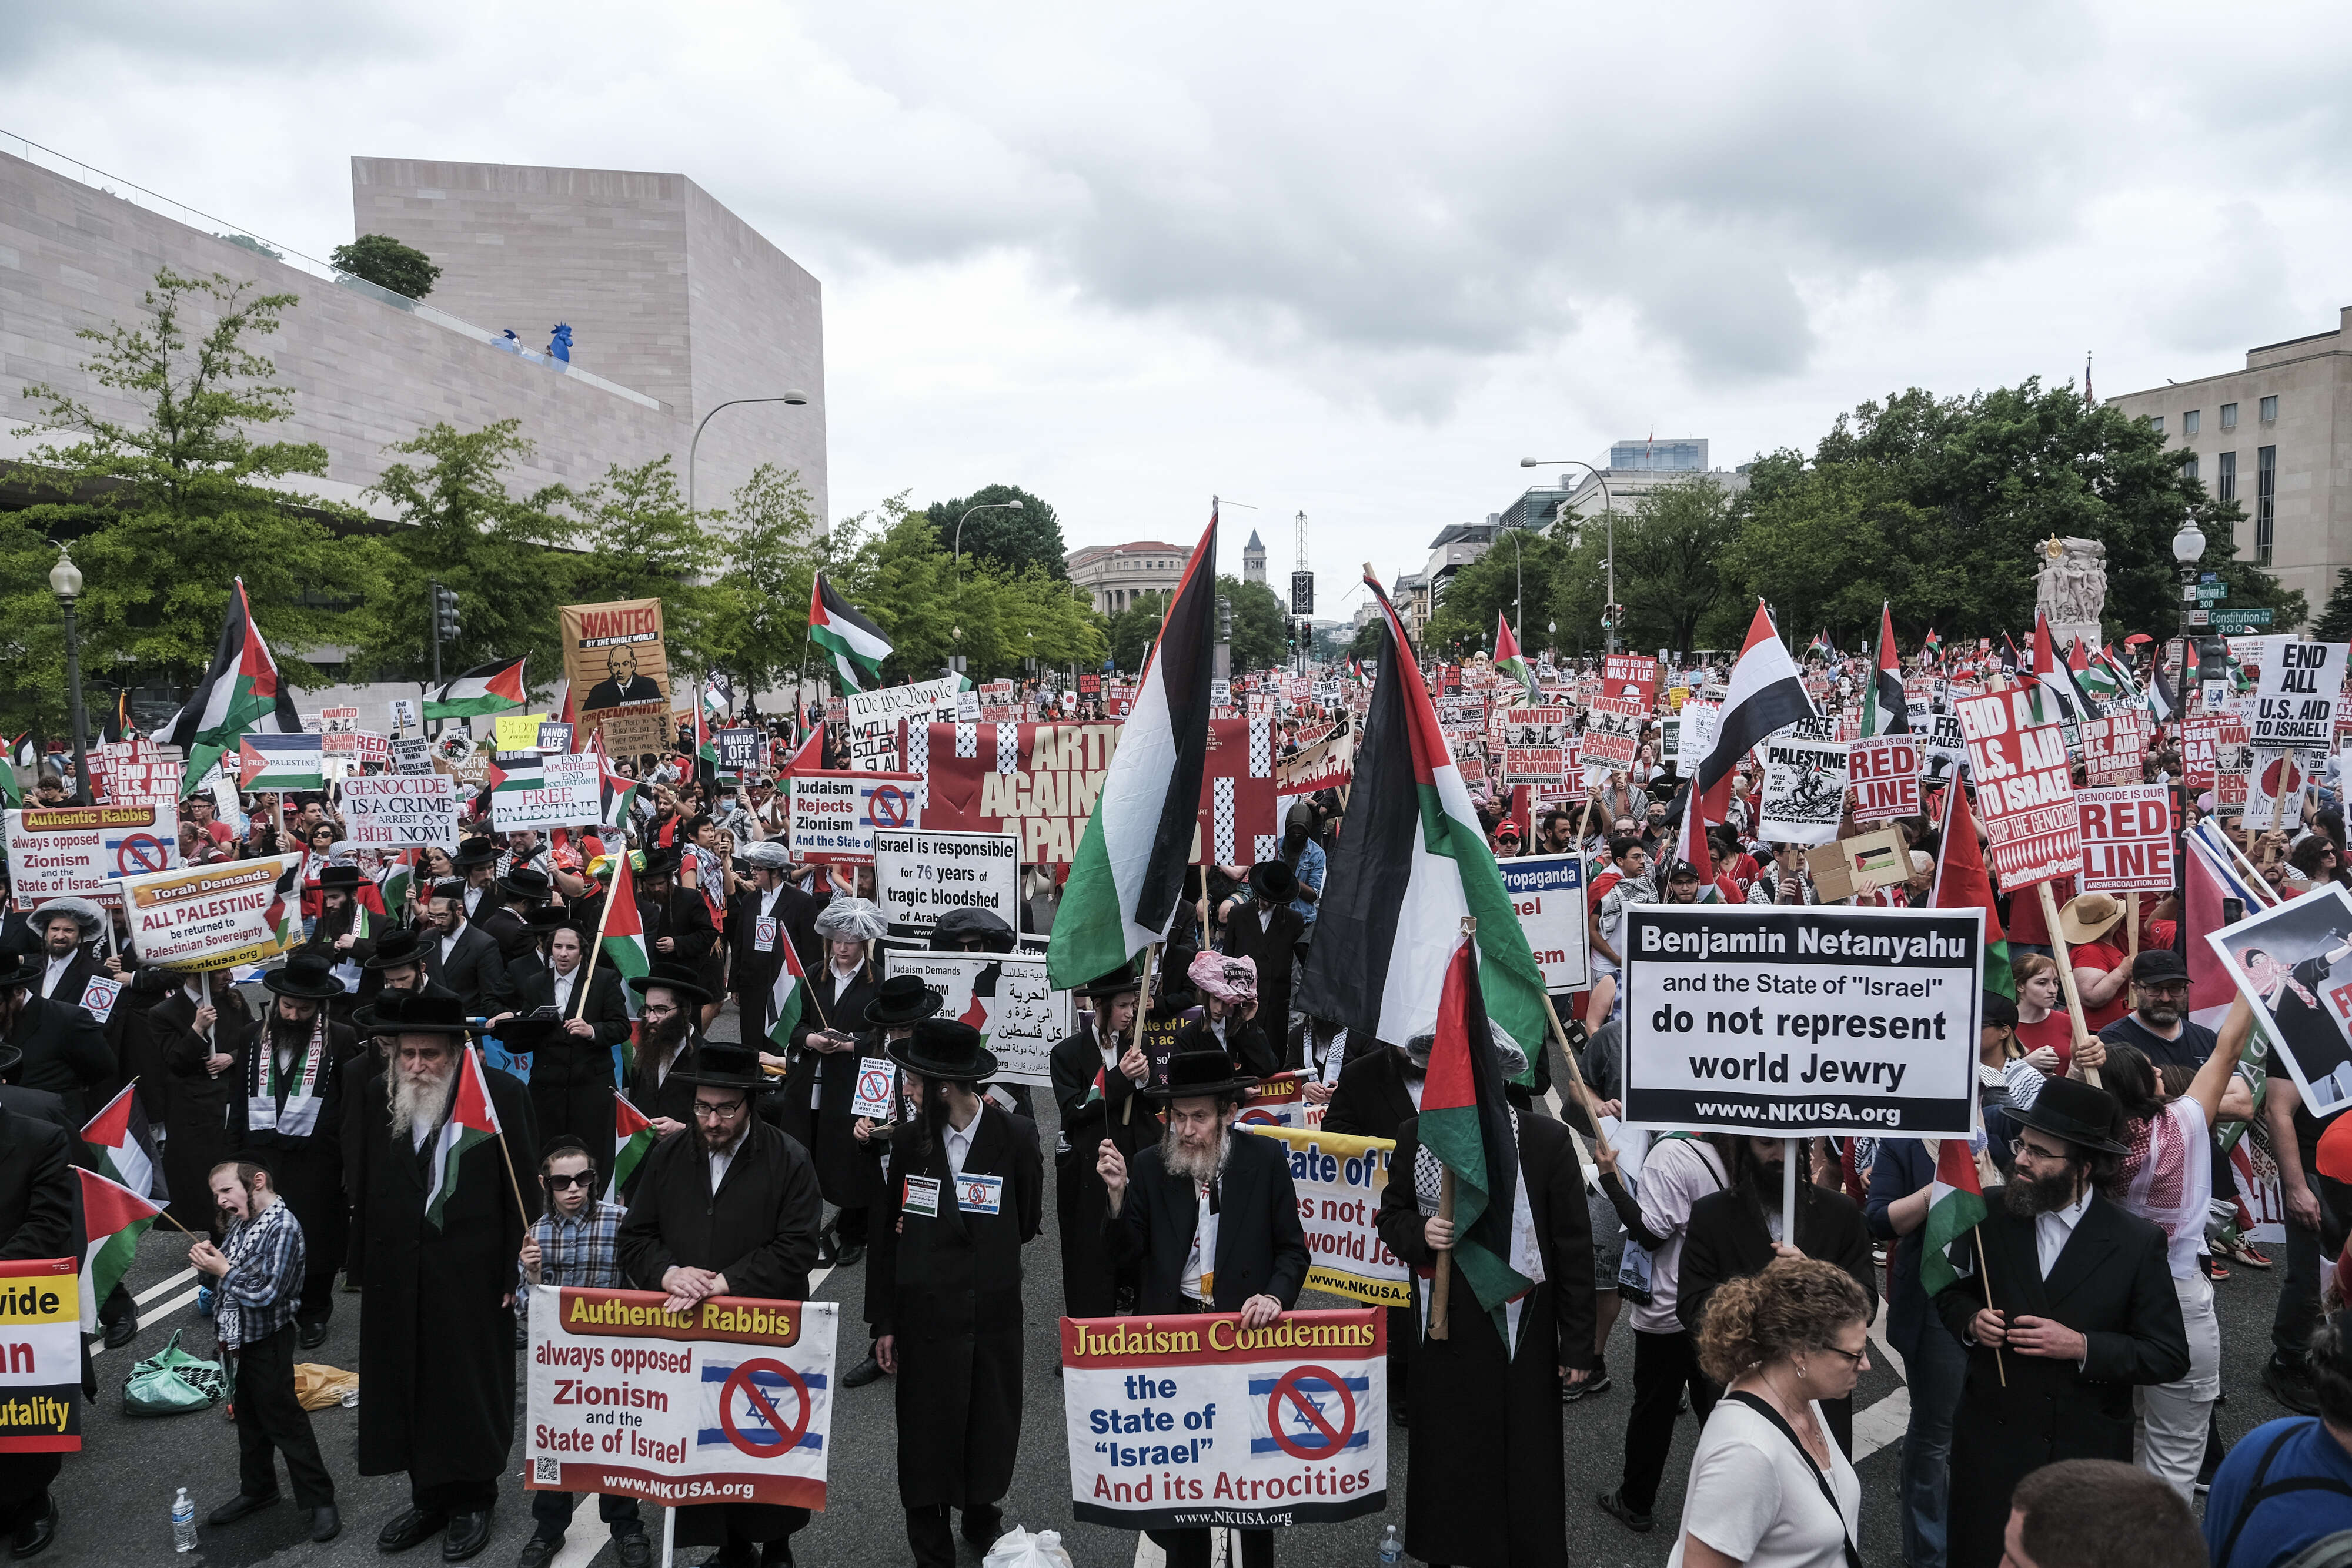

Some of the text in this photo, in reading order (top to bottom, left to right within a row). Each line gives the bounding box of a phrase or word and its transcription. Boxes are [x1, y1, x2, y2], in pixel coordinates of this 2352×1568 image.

[2197, 585, 2219, 598] Pennsylvania
[580, 608, 656, 638] WANTED
[2211, 611, 2259, 623] Constitution
[610, 636, 632, 645] WHOLE
[633, 633, 655, 643] WORLD!
[1608, 658, 1655, 669] BIDEN'S RED LINE
[2282, 644, 2327, 669] END
[1607, 667, 1653, 681] WAS A LIE!
[2280, 669, 2317, 693] ALL
[1321, 681, 1338, 691] FREE
[853, 695, 878, 714] We
[901, 680, 952, 707] People
[323, 708, 357, 718] WANTED
[1508, 710, 1562, 723] WANTED
[1956, 696, 2008, 741] END
[2259, 698, 2330, 720] U.S. AID
[852, 719, 895, 740] WILL
[2255, 721, 2327, 738] TO ISRAEL!
[393, 738, 426, 747] RESISTANCE
[723, 734, 754, 745] HANDS
[402, 745, 427, 754] JUSTIFIED
[729, 744, 751, 760] OFF
[1507, 750, 1562, 761] BENJAMIN
[1769, 747, 1847, 770] PALESTINE
[1969, 738, 2017, 783] U.S.
[2019, 727, 2066, 773] AID
[544, 762, 599, 773] APARTHEID
[561, 755, 583, 764] END
[1506, 762, 1562, 773] NETANYAHU
[544, 778, 596, 788] OCCUPATION!!
[562, 771, 583, 780] END
[344, 778, 448, 795] GENOCIDE
[522, 787, 573, 805] FREE
[796, 781, 853, 795] Judaism
[1978, 767, 2074, 817] TO ISRAEL
[2077, 788, 2164, 803] GENOCIDE IS OUR
[350, 797, 453, 814] IS A CRIME
[496, 801, 599, 823] PALESTINE
[797, 798, 853, 815] Rejects
[28, 808, 151, 827] Authentic Rabbis
[377, 815, 418, 824] ARREST
[796, 816, 853, 830] Zionism
[1988, 803, 2078, 845] STOP THE GENOCIDE
[2079, 800, 2167, 840] RED
[12, 833, 99, 851] always opposed
[357, 826, 450, 842] BIBI NOW!
[795, 834, 861, 847] And the State
[877, 835, 1013, 859] Israel is responsible
[24, 854, 89, 868] Zionism
[2082, 843, 2171, 878] LINE
[901, 865, 988, 884] for 76 years of
[1501, 866, 1576, 890] Propaganda
[17, 877, 65, 892] State of
[151, 870, 270, 900] Torah Demands
[2087, 879, 2169, 890] ANSWERCOALITION.ORG
[887, 887, 999, 908] tragic bloodshed
[142, 892, 266, 931] ALL PALESTINE
[900, 912, 911, 922] of
[169, 918, 235, 940] be returned to
[145, 926, 263, 959] Palestinian Sovereignty
[1641, 925, 1966, 964] Benjamin Netanyahu
[893, 965, 960, 975] Judaism Demands
[1009, 983, 1049, 1004] الحرية
[1662, 973, 1943, 998] and the State of "Israel"
[1015, 1007, 1034, 1021] غزة
[1652, 1003, 1946, 1044] do not represent
[998, 1022, 1063, 1042] كل فلسطين
[1689, 1052, 1907, 1092] world Jewry
[1695, 1101, 1902, 1126] www.NKUSA.org
[569, 1297, 791, 1336] Authentic Rabbis
[1073, 1318, 1375, 1357] Judaism Condemns
[536, 1340, 693, 1375] always opposed
[553, 1379, 669, 1413] Zionism
[1124, 1374, 1177, 1400] the
[586, 1410, 643, 1427] and the
[1090, 1403, 1216, 1435] State of
[536, 1424, 687, 1463] State of Israel
[603, 1475, 754, 1499] www.NKUSA.org
[1094, 1465, 1369, 1503] And its Atrocities
[1174, 1511, 1293, 1526] www.NKUSA.org
